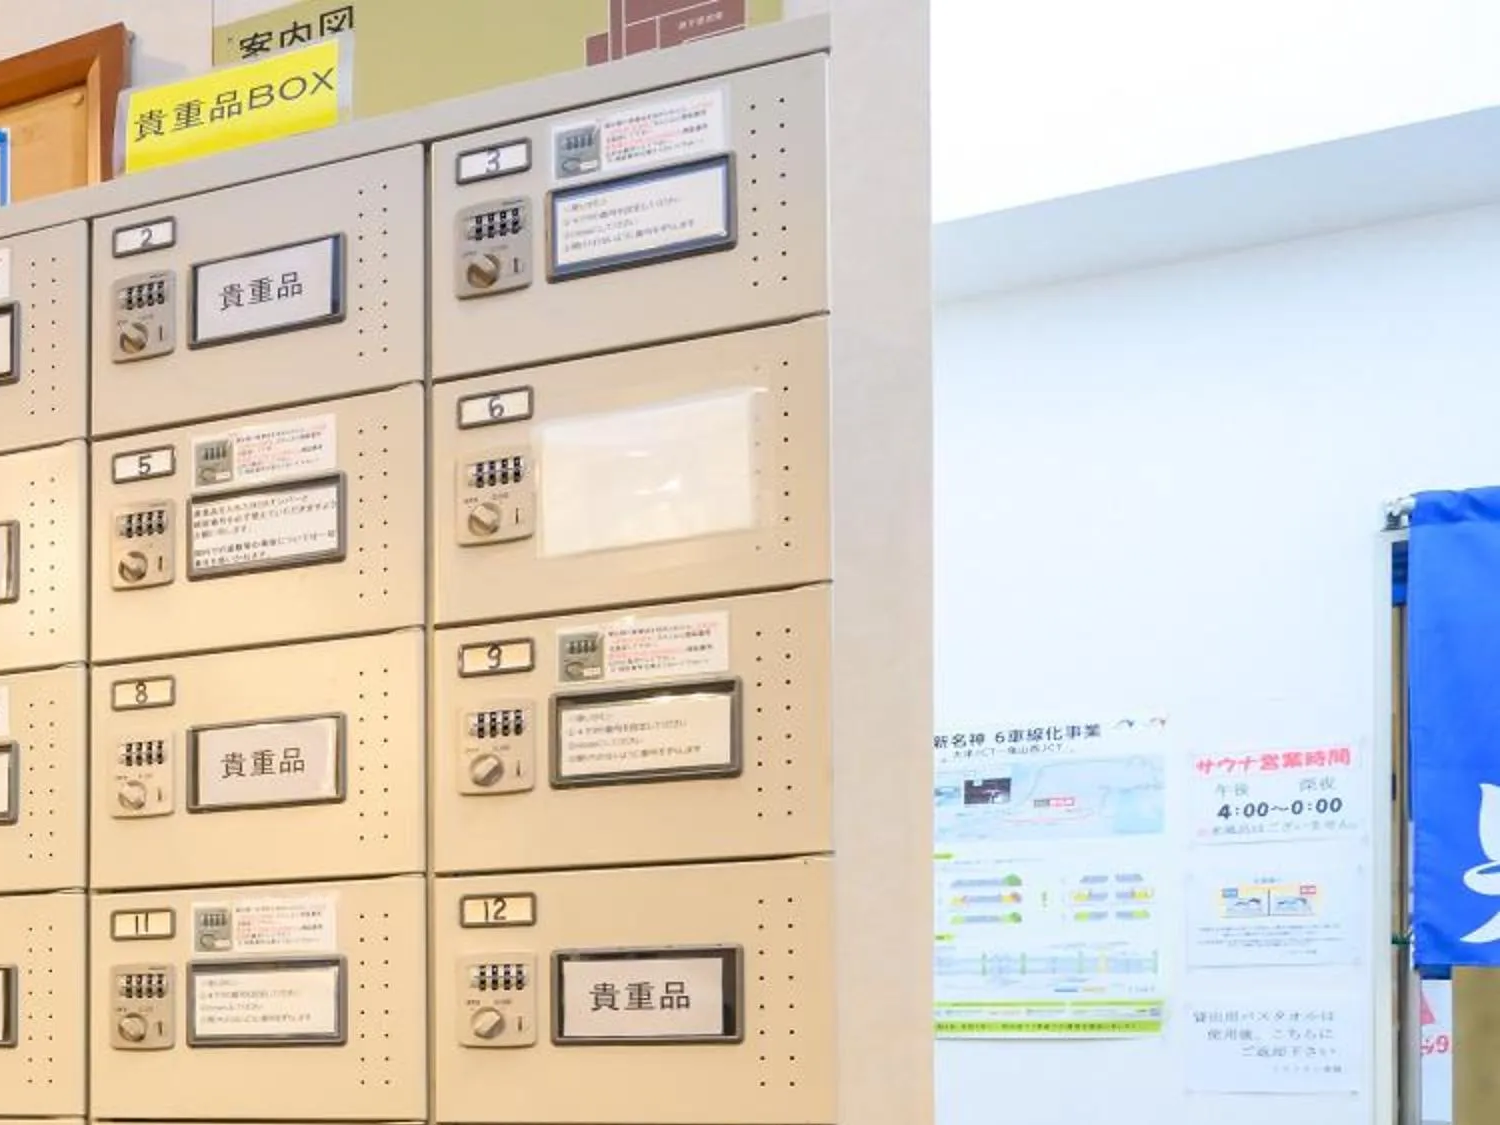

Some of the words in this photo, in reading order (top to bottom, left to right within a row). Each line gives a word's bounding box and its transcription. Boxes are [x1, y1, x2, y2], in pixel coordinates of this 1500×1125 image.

[134, 67, 335, 142] 貴重品BOX
[485, 148, 500, 173] 3
[141, 228, 153, 246] 2
[218, 271, 303, 310] 貴重品
[487, 396, 504, 418] 6
[138, 454, 151, 474] 5
[487, 644, 503, 668] 9
[136, 680, 148, 703] 8
[220, 747, 305, 779] 貴重品
[1195, 748, 1352, 774] サウナ営業時間
[484, 897, 507, 922] 12
[135, 913, 149, 934] 11
[589, 981, 691, 1012] 貴重品
